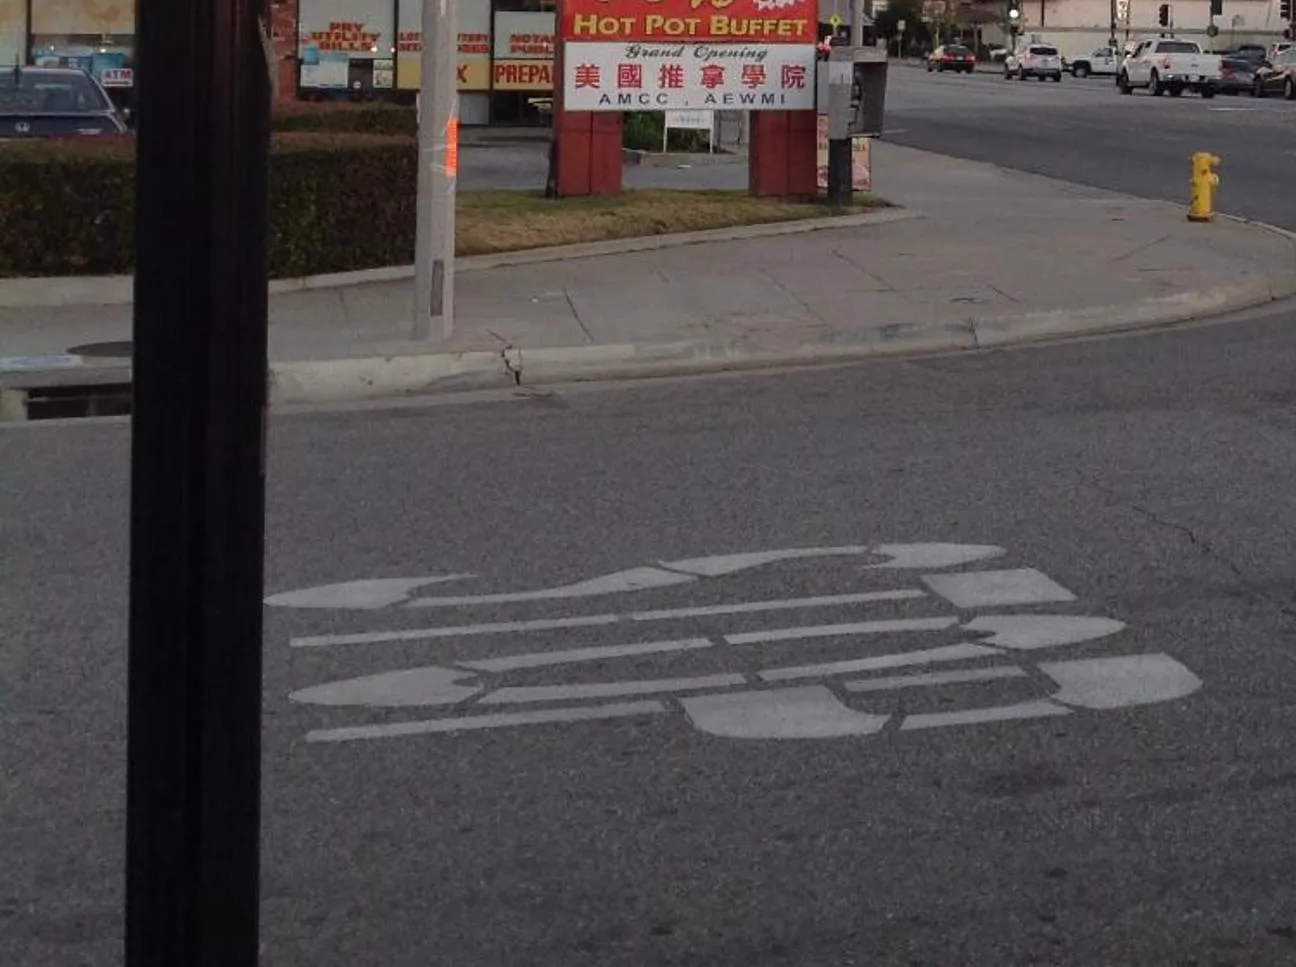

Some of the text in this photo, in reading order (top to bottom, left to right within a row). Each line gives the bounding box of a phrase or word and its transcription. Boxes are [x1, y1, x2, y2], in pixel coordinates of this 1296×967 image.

[573, 13, 808, 36] HOT POT BUFFET
[624, 43, 768, 60] Grand Opening
[104, 69, 133, 81] ATM
[574, 64, 807, 91] 美國推拿學院
[599, 92, 669, 105] AMCC
[704, 92, 787, 106] AEWMI
